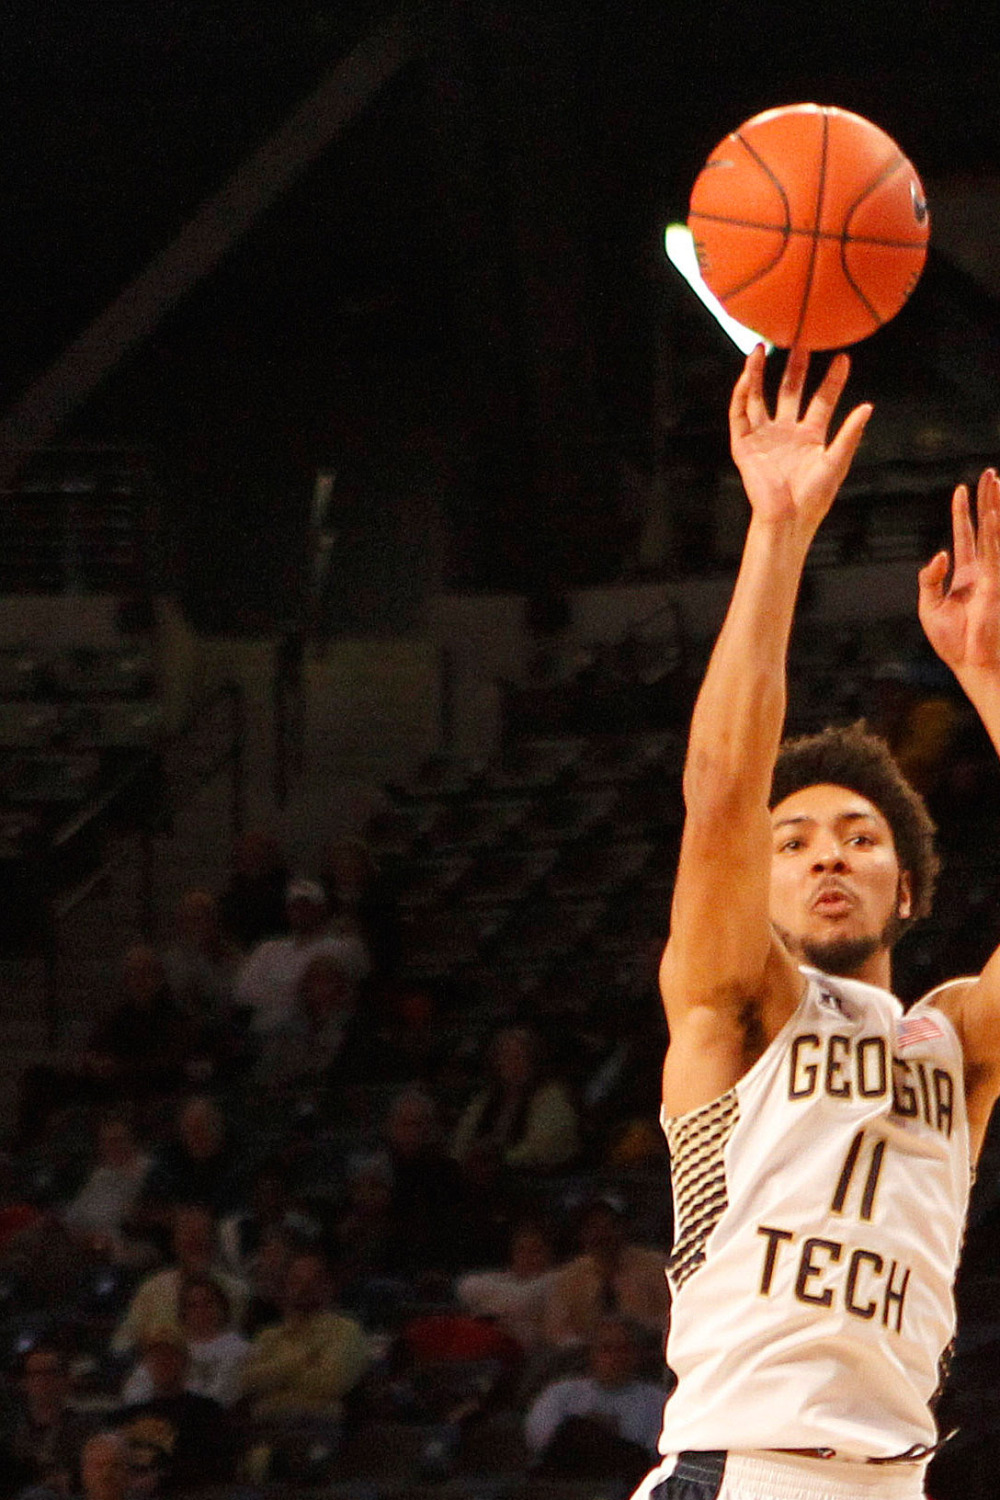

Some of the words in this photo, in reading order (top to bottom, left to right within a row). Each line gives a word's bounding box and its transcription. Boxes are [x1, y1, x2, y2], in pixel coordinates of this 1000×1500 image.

[788, 1032, 953, 1140] GEOGIA
[830, 1130, 888, 1223] 11
[756, 1225, 911, 1334] TECH
